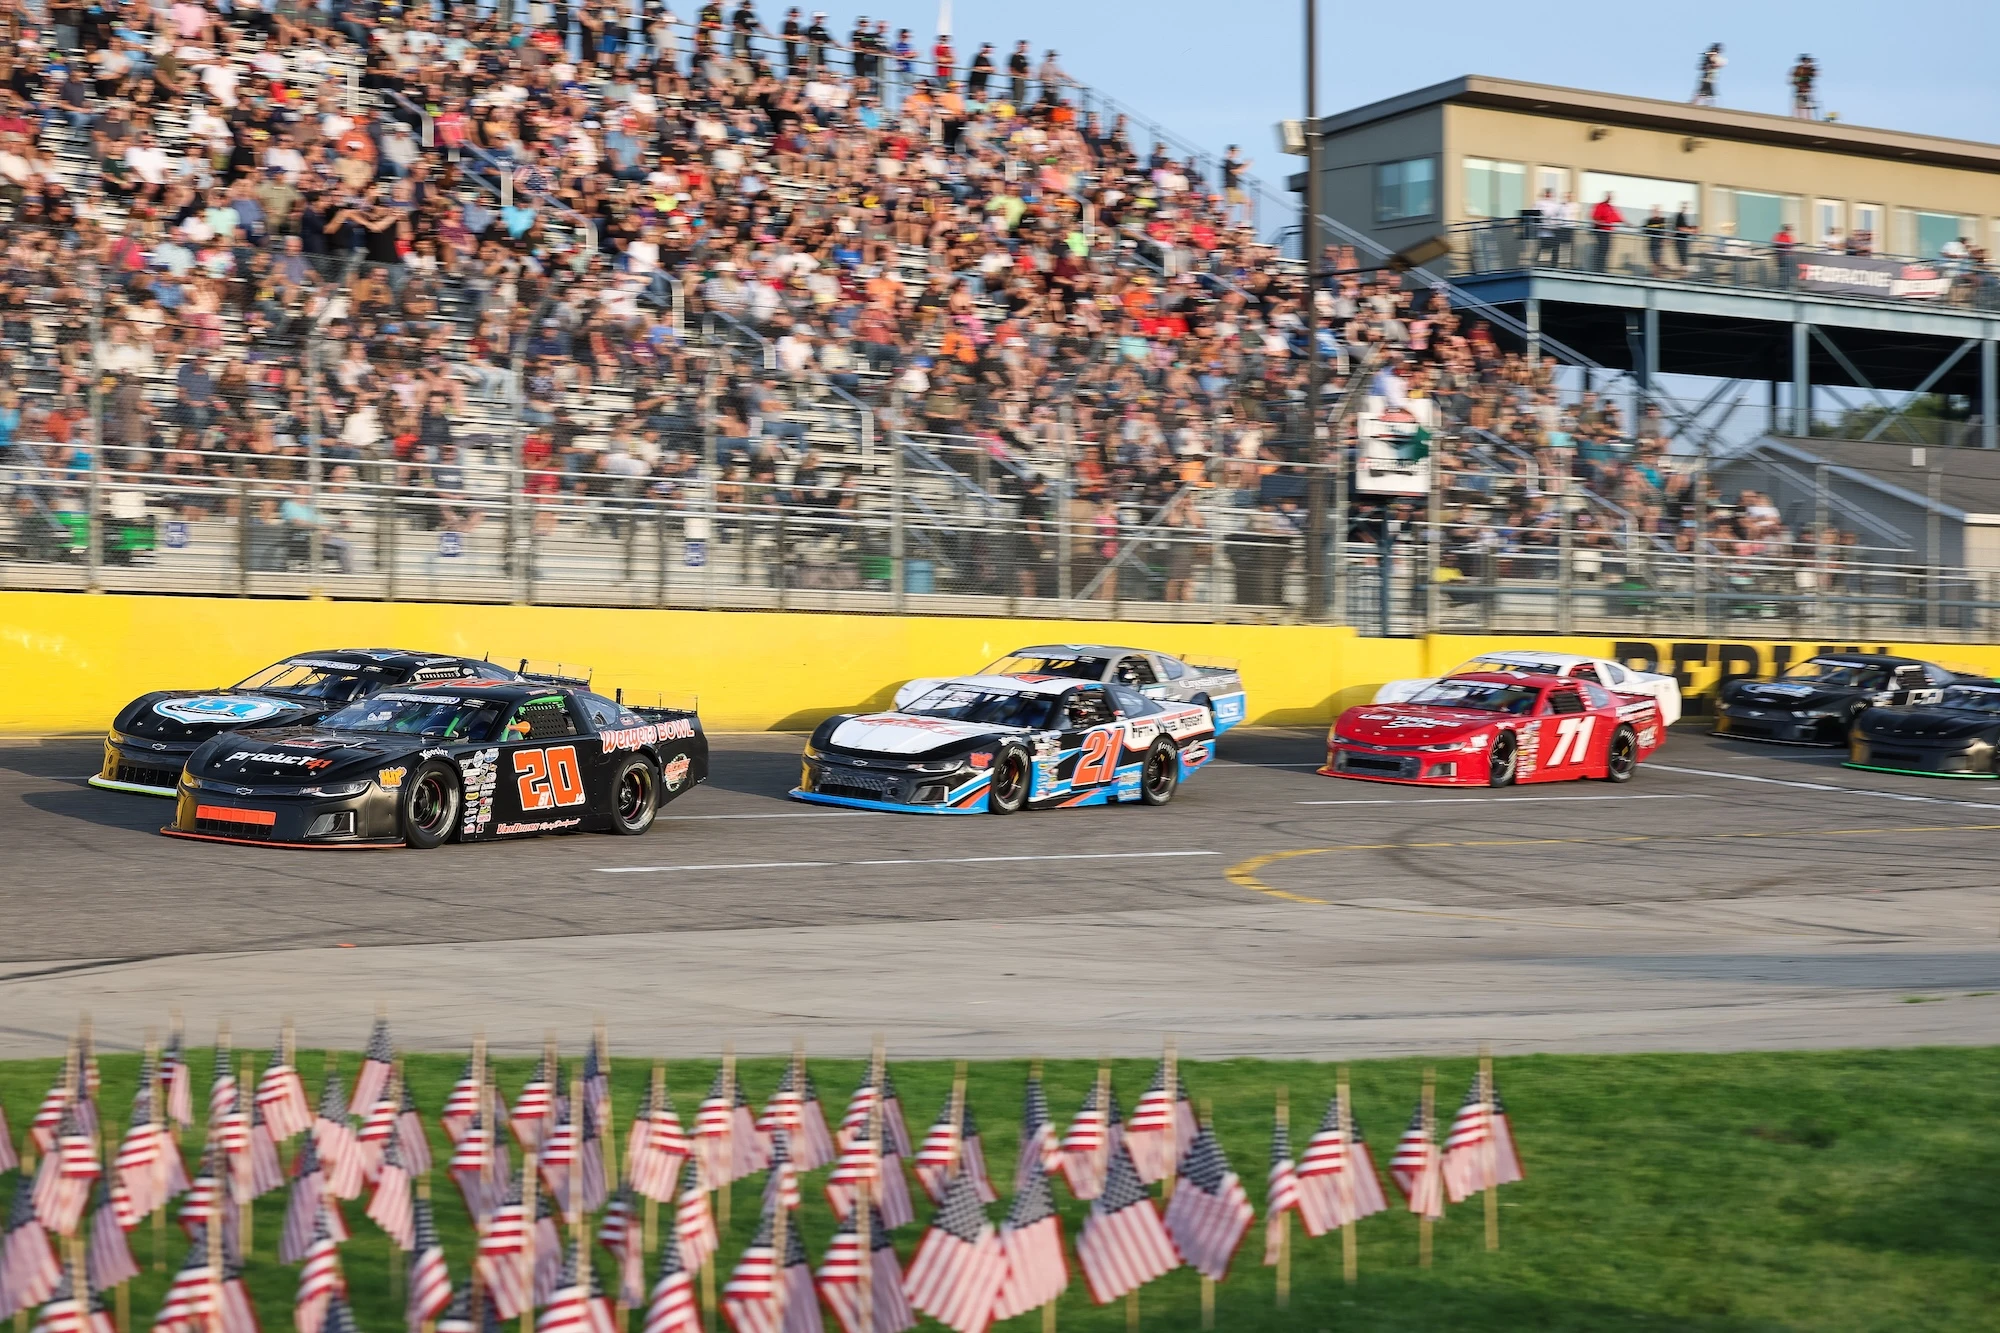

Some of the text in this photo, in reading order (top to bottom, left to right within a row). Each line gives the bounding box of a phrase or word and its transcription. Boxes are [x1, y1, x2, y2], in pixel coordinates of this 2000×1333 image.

[655, 718, 695, 742] BOWL
[1070, 727, 1125, 787] 21
[1545, 715, 1596, 766] 71
[512, 744, 586, 812] 20
